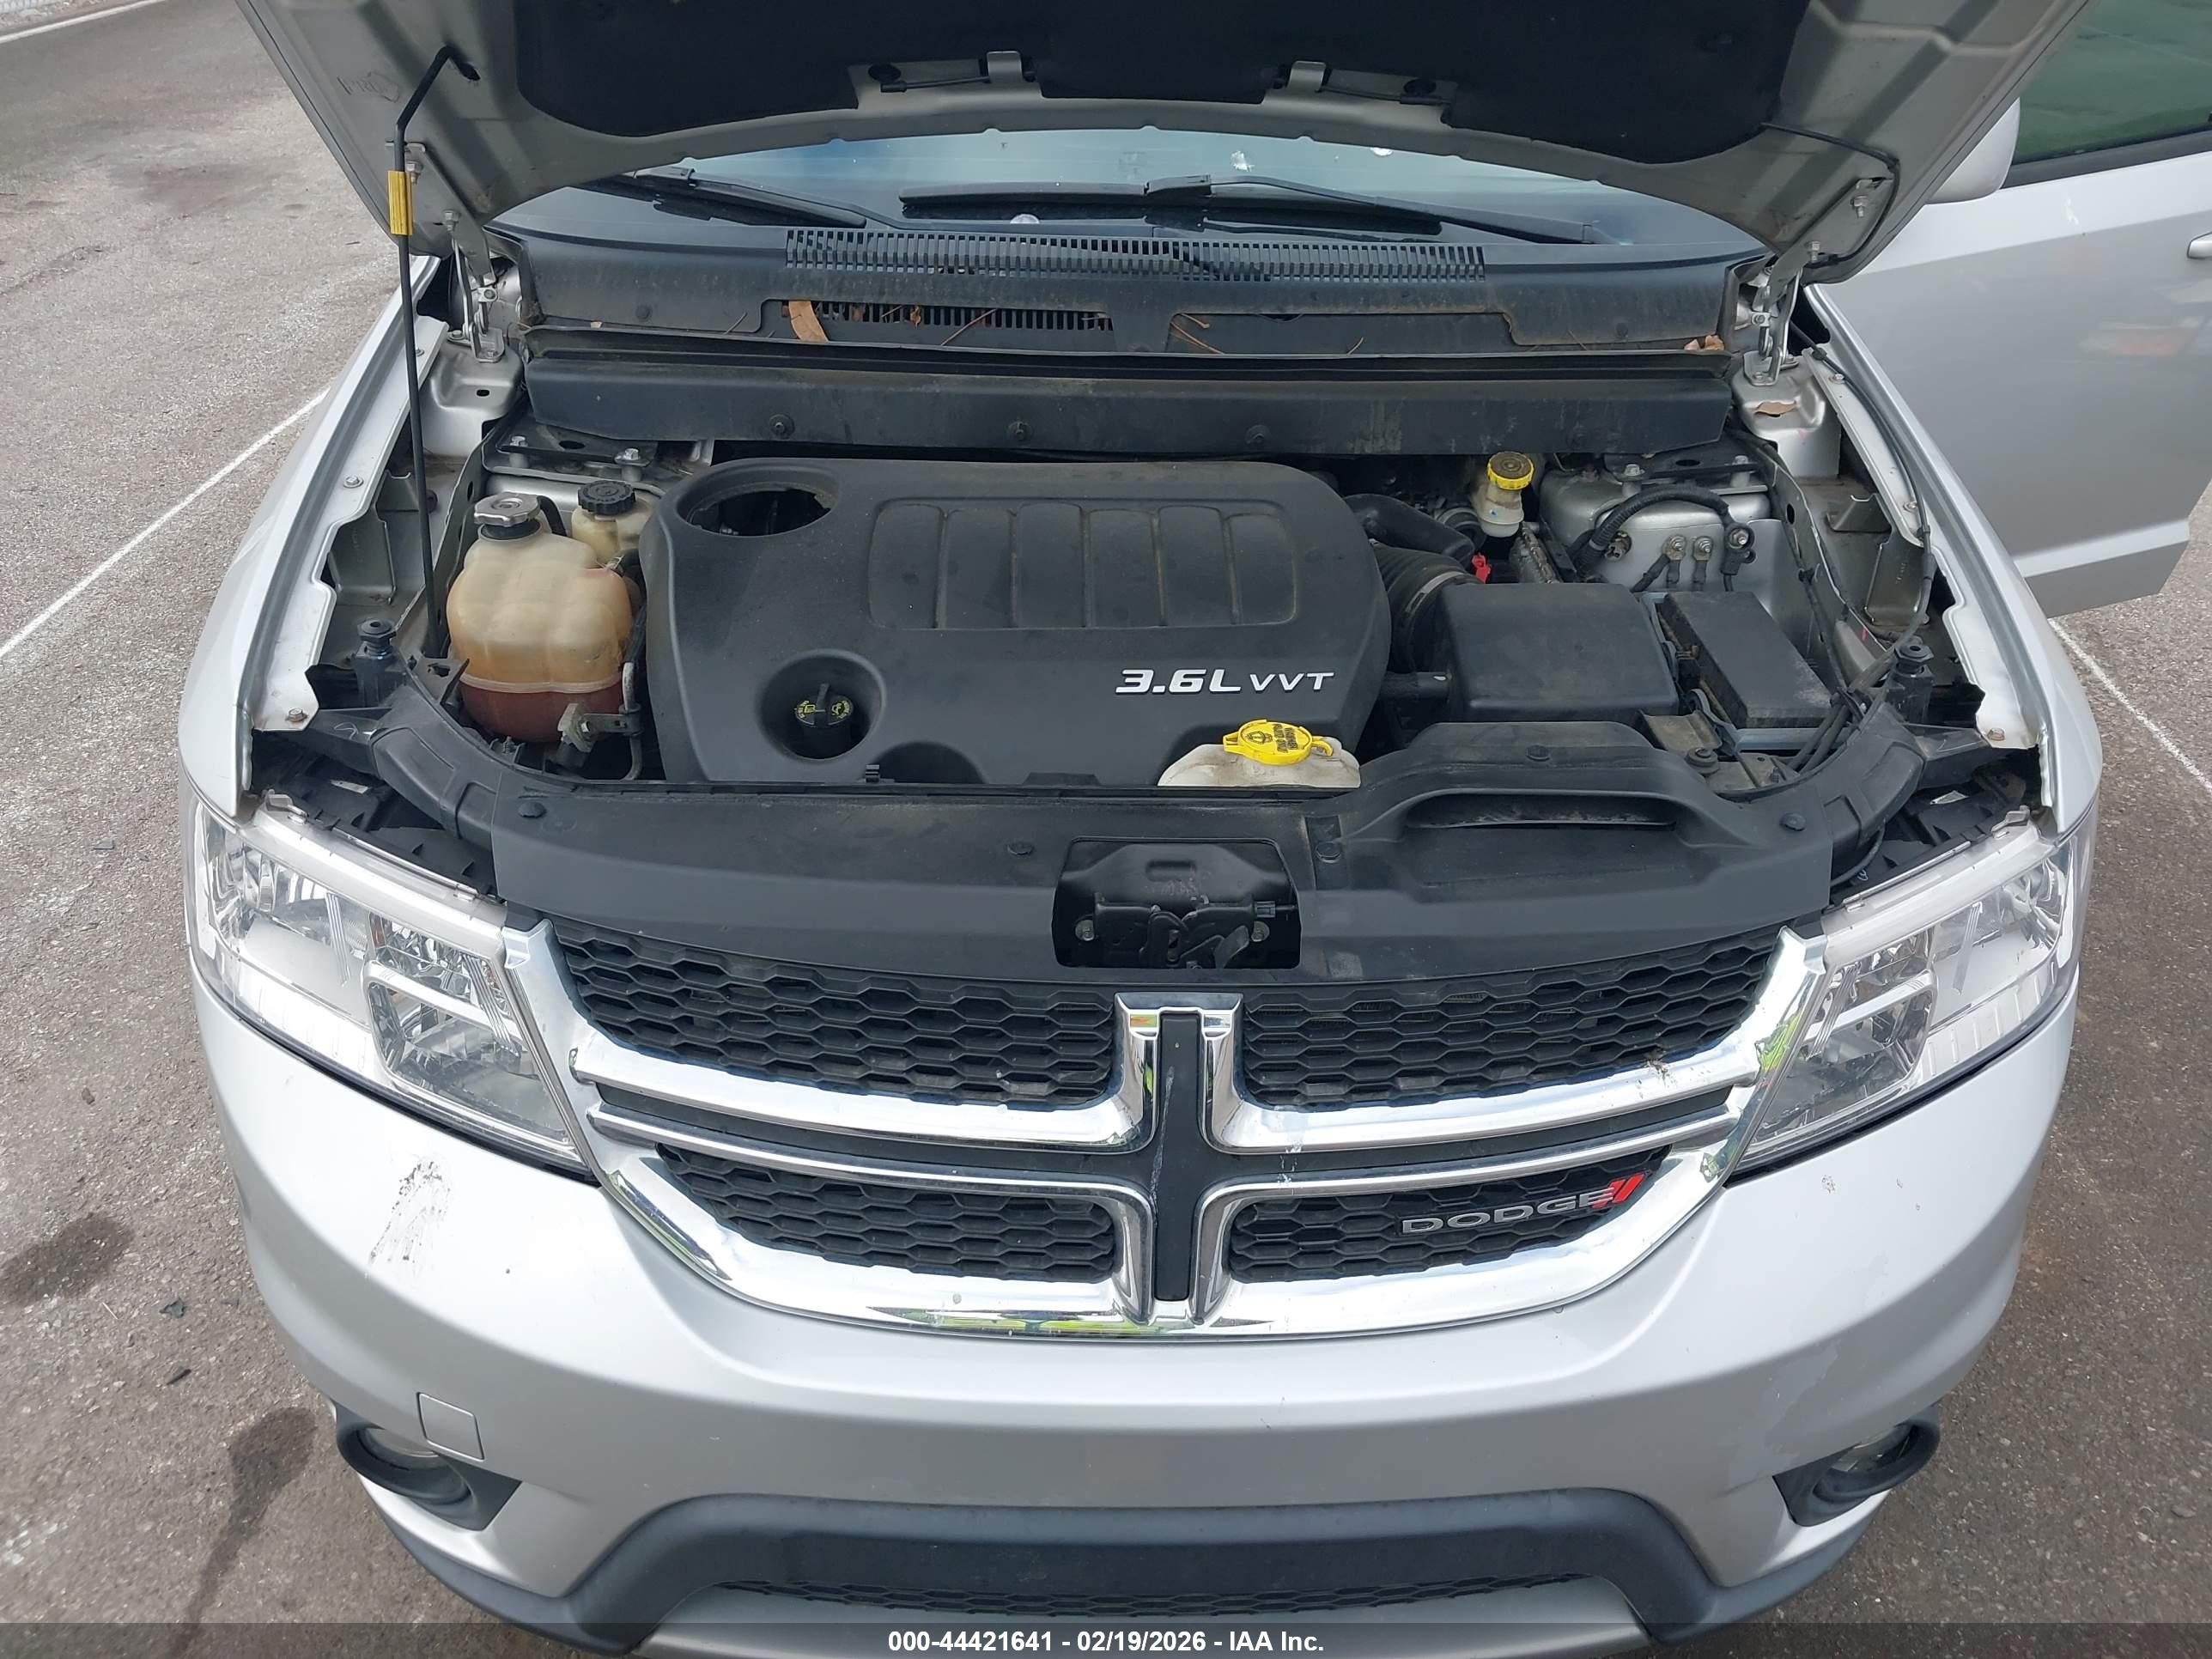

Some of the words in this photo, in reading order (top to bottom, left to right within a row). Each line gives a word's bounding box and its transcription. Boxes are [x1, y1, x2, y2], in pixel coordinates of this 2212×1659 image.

[1115, 669, 1242, 694] 3.6L
[1249, 671, 1335, 692] VVT
[1401, 1186, 1615, 1234] DODGE
